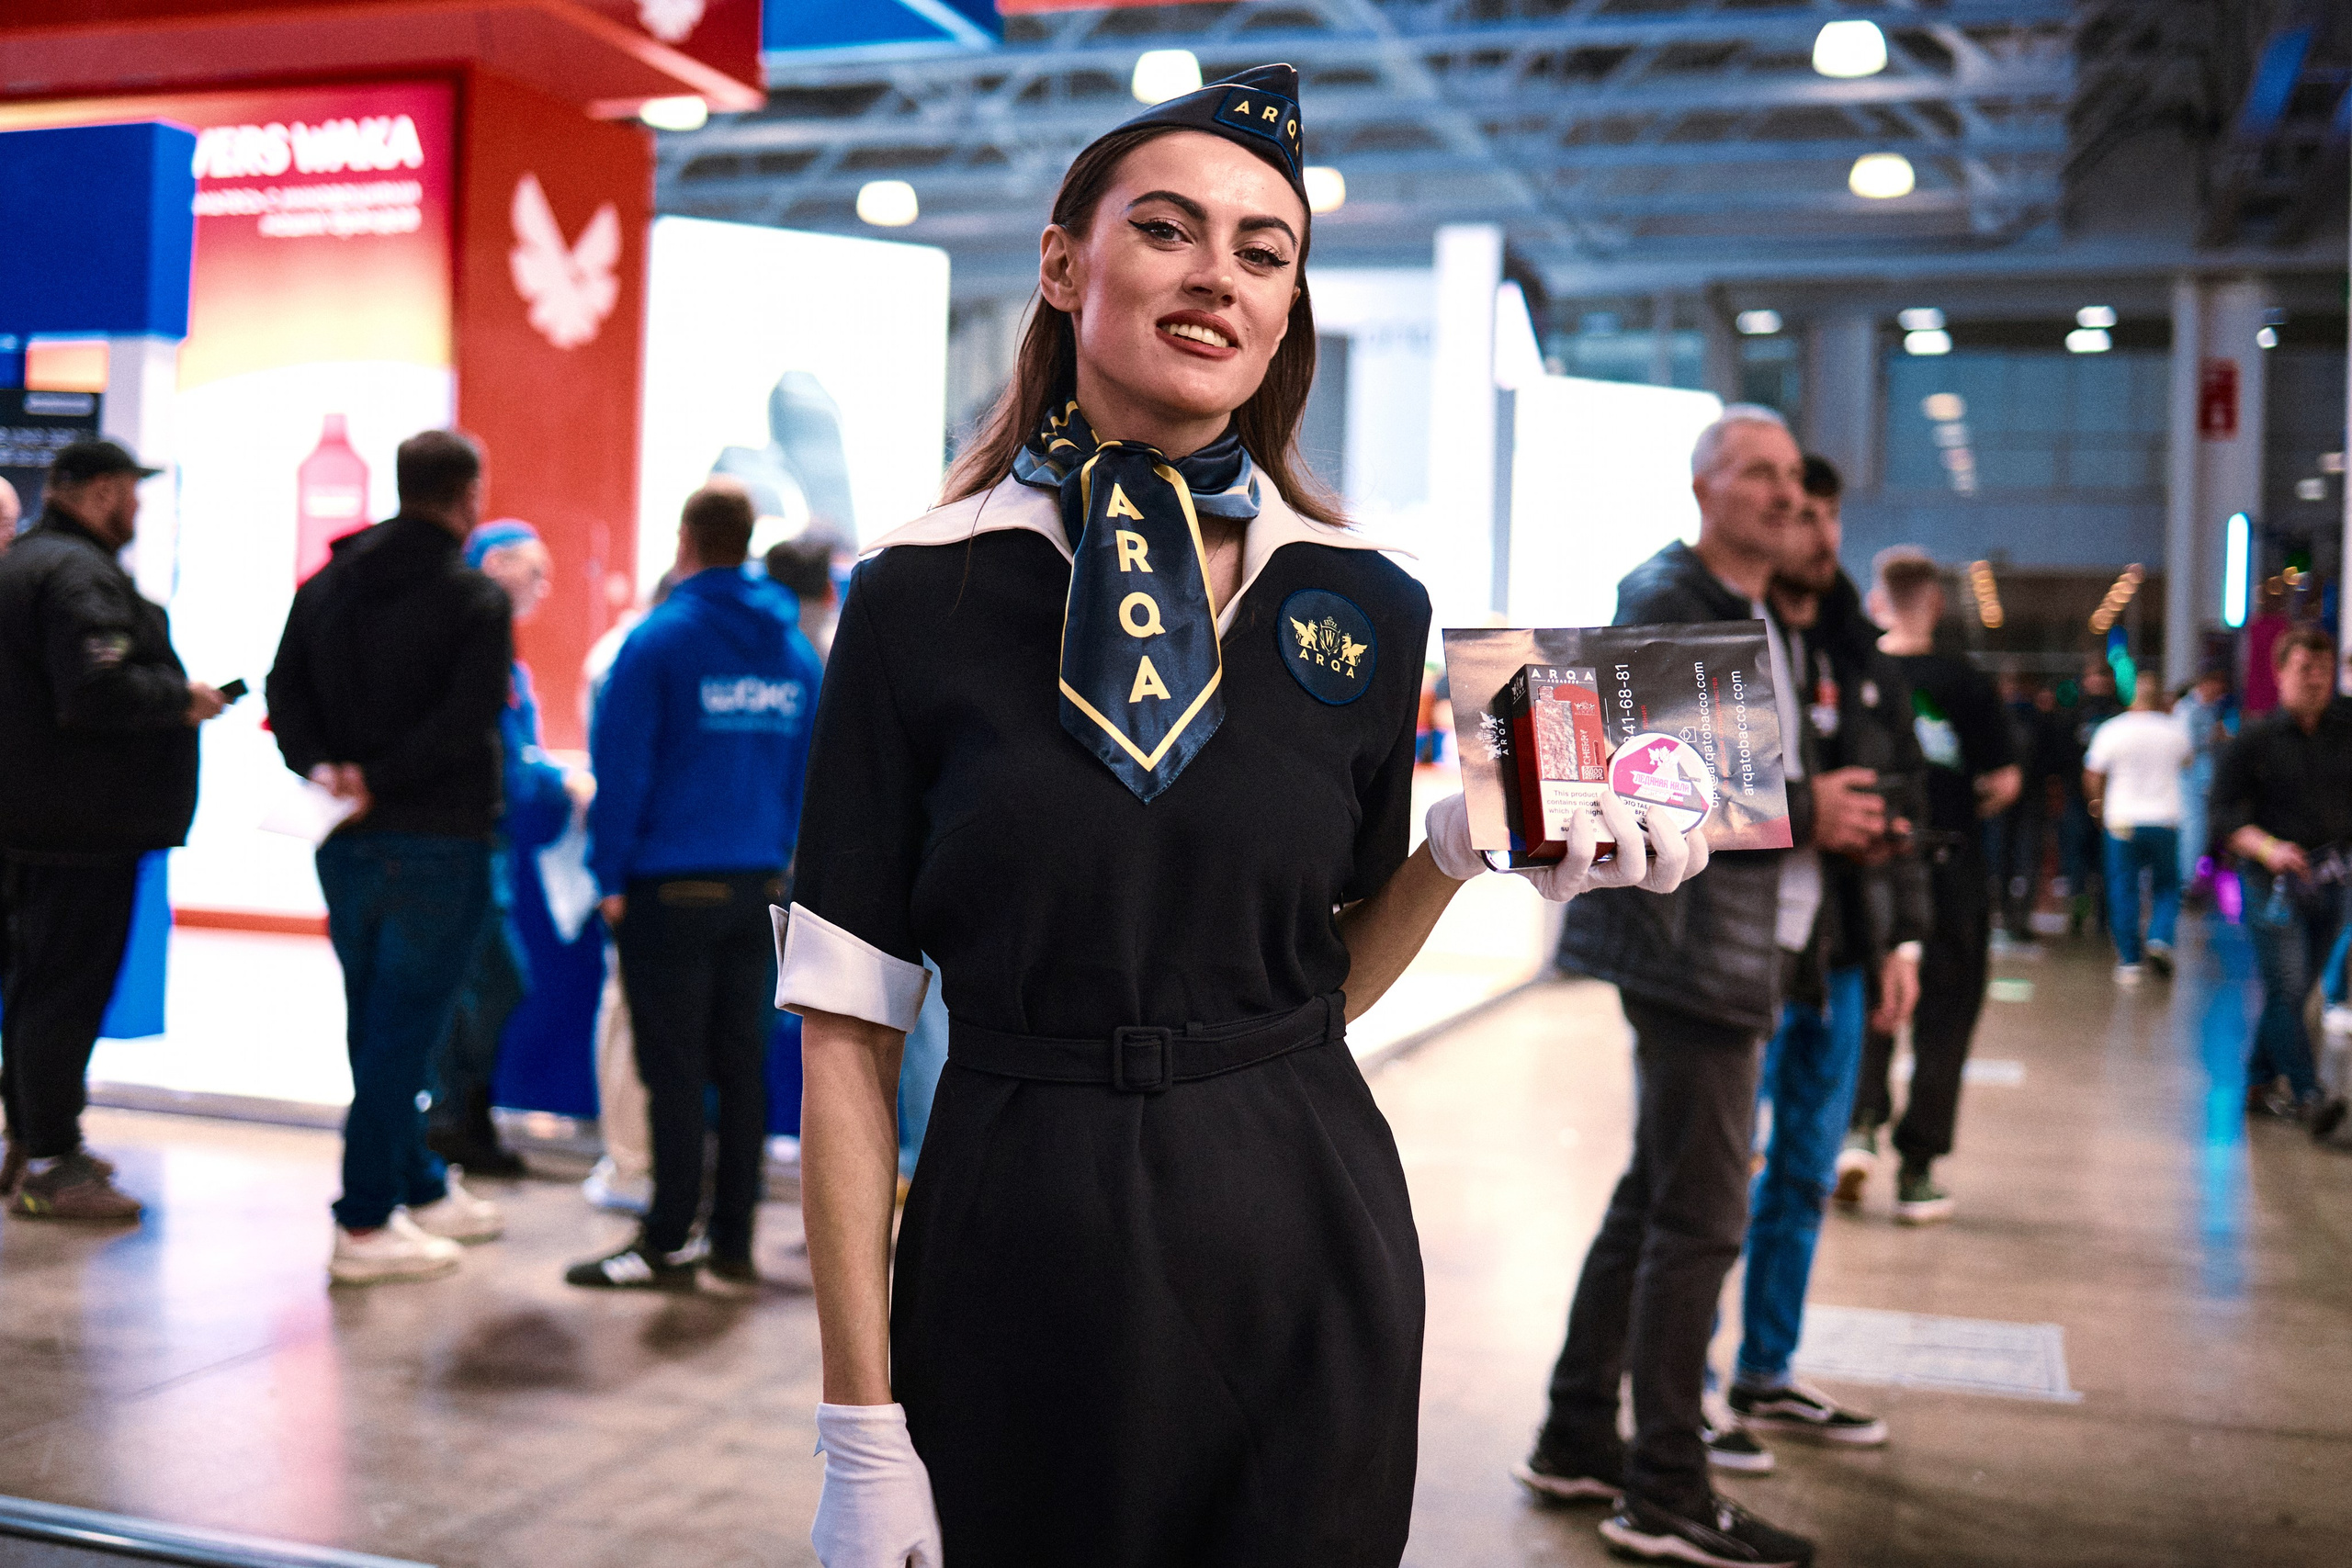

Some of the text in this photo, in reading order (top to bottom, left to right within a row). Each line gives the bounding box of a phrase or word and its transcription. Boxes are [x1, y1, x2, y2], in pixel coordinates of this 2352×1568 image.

[289, 114, 424, 175] WAKA
[1106, 482, 1171, 704] ARQA
[1324, 629, 1336, 648] W
[1298, 648, 1355, 679] ARQA
[1531, 668, 1595, 681] ARQA
[1498, 717, 1510, 755] ARQA
[1640, 705, 1649, 730] линия
[1731, 671, 1756, 796] arqatobacco.com
[1579, 728, 1591, 765] CHERRY
